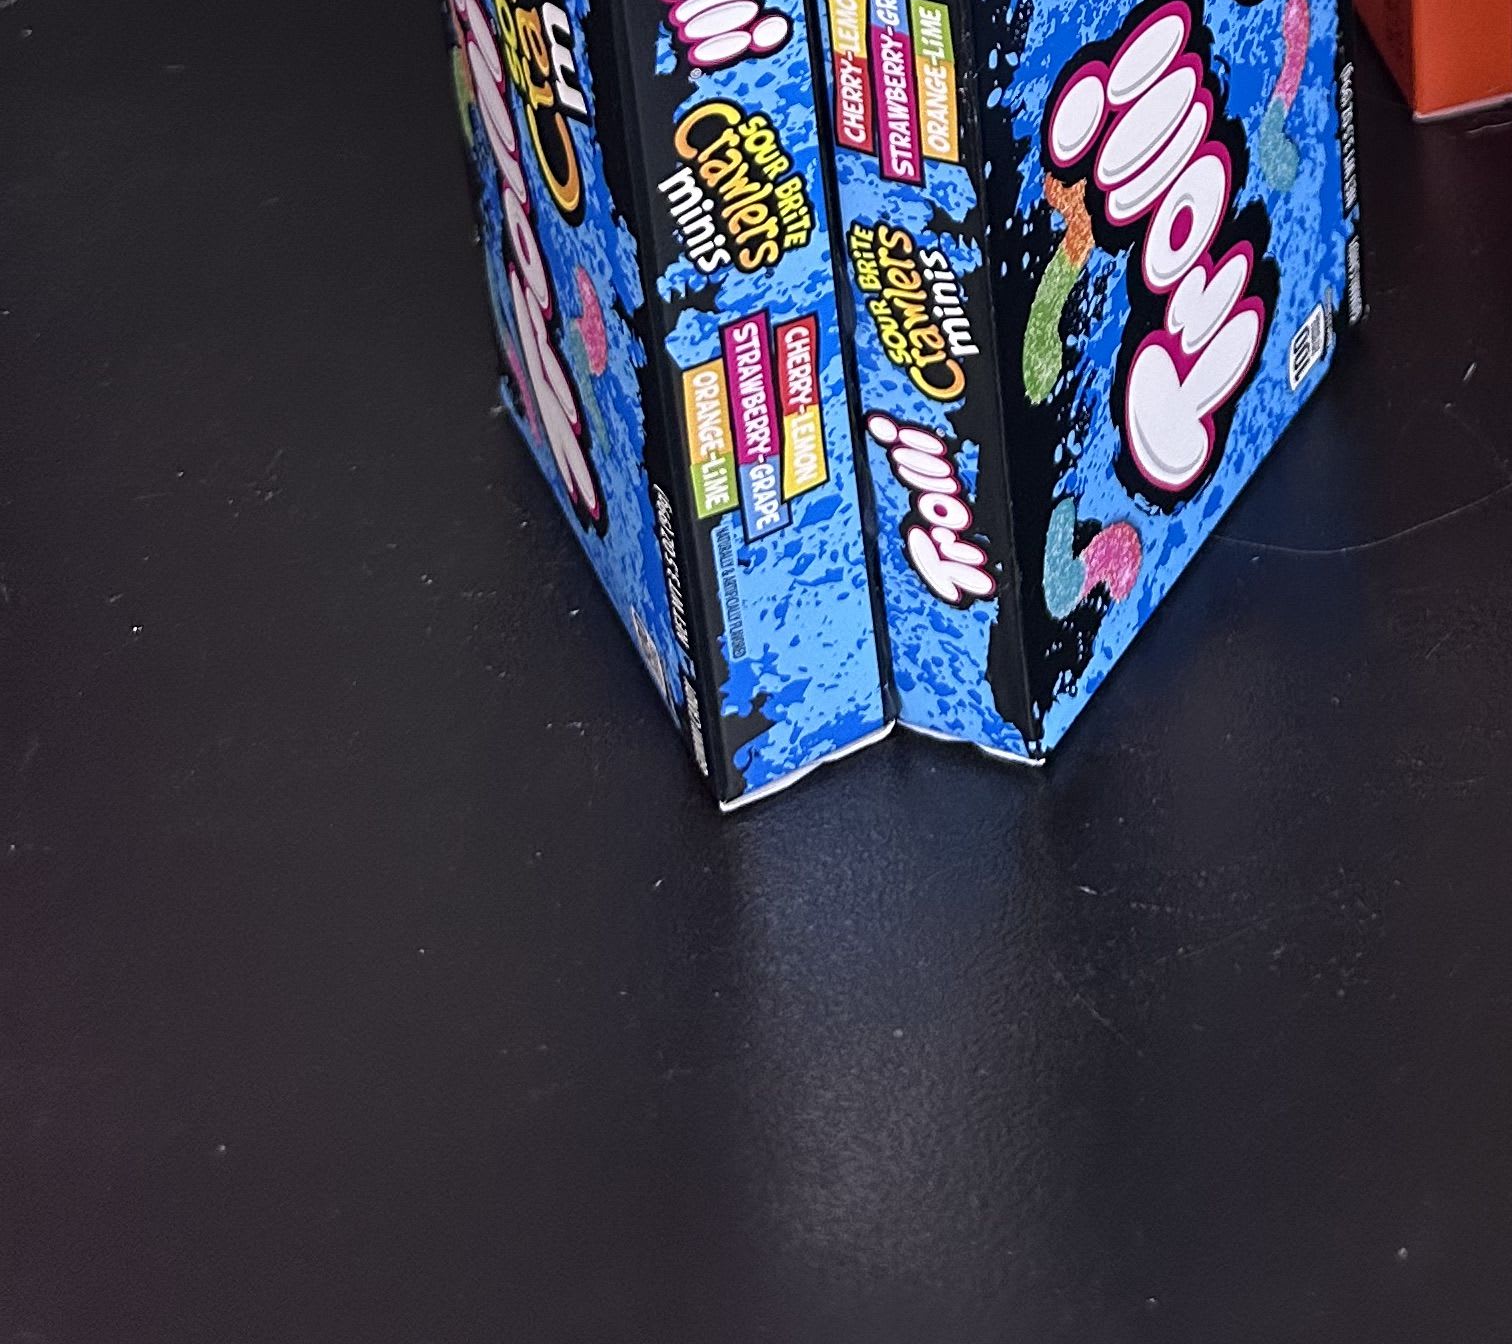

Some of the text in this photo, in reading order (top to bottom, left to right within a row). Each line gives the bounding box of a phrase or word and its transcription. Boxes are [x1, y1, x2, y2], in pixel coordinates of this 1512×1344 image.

[657, 166, 731, 274] minis
[675, 102, 780, 271] Crawlers
[738, 114, 790, 176] SOUR
[878, 224, 966, 400] Crawlers
[920, 248, 979, 357] minis
[1047, 1, 1265, 491] Trolli
[783, 325, 820, 485] CHERRY-LEMON
[868, 299, 912, 365] SOUR
[1293, 325, 1311, 382] 100
[732, 321, 782, 531] STRAWBERRY-GRAPE
[866, 414, 997, 603] Trolli
